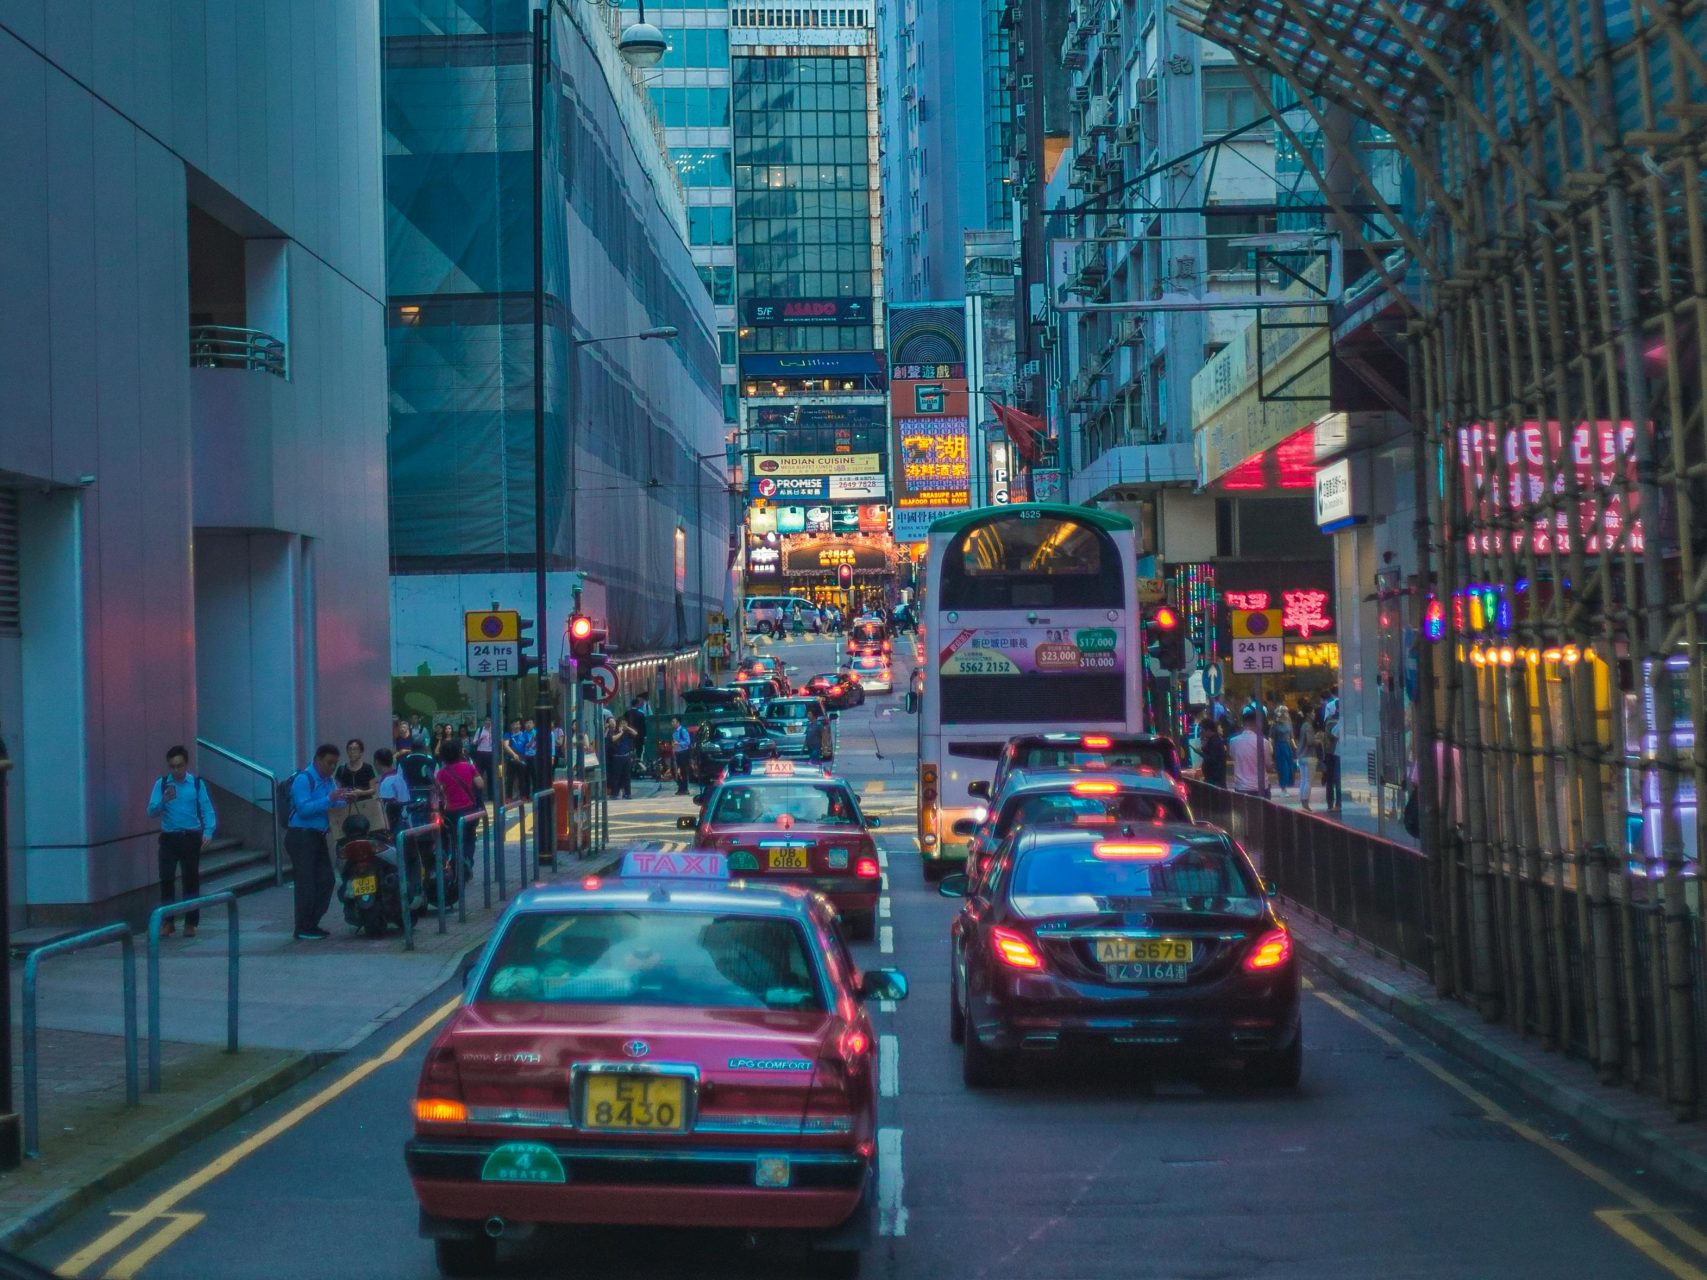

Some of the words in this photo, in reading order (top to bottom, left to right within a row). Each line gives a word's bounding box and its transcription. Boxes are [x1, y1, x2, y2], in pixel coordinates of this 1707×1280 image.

[757, 307, 773, 316] 5/F
[783, 303, 836, 316] ASADO
[817, 456, 855, 465] CUISINE
[998, 470, 1007, 482] P
[777, 478, 822, 488] PROMISE
[1020, 511, 1040, 519] 4525
[1080, 638, 1113, 648] $17,000
[1239, 643, 1255, 652] 24
[1258, 643, 1277, 652] hrs
[474, 646, 490, 656] 24
[493, 646, 512, 655] hrs
[1041, 651, 1076, 661] $23,000
[960, 662, 983, 672] 5562
[986, 662, 1010, 672] 2152
[1080, 658, 1114, 667] $10,000
[767, 763, 792, 771] TAXI
[780, 849, 795, 858] DB
[633, 855, 719, 873] TAXI
[774, 857, 802, 867] 6186
[1103, 944, 1129, 959] AH
[1134, 943, 1187, 959] 6678
[729, 1059, 755, 1069] LPG
[757, 1060, 813, 1070] COMFORT
[616, 1076, 655, 1104] ET
[595, 1101, 675, 1126] 8430
[515, 1154, 531, 1169] 4
[500, 1170, 548, 1180] SEATS
